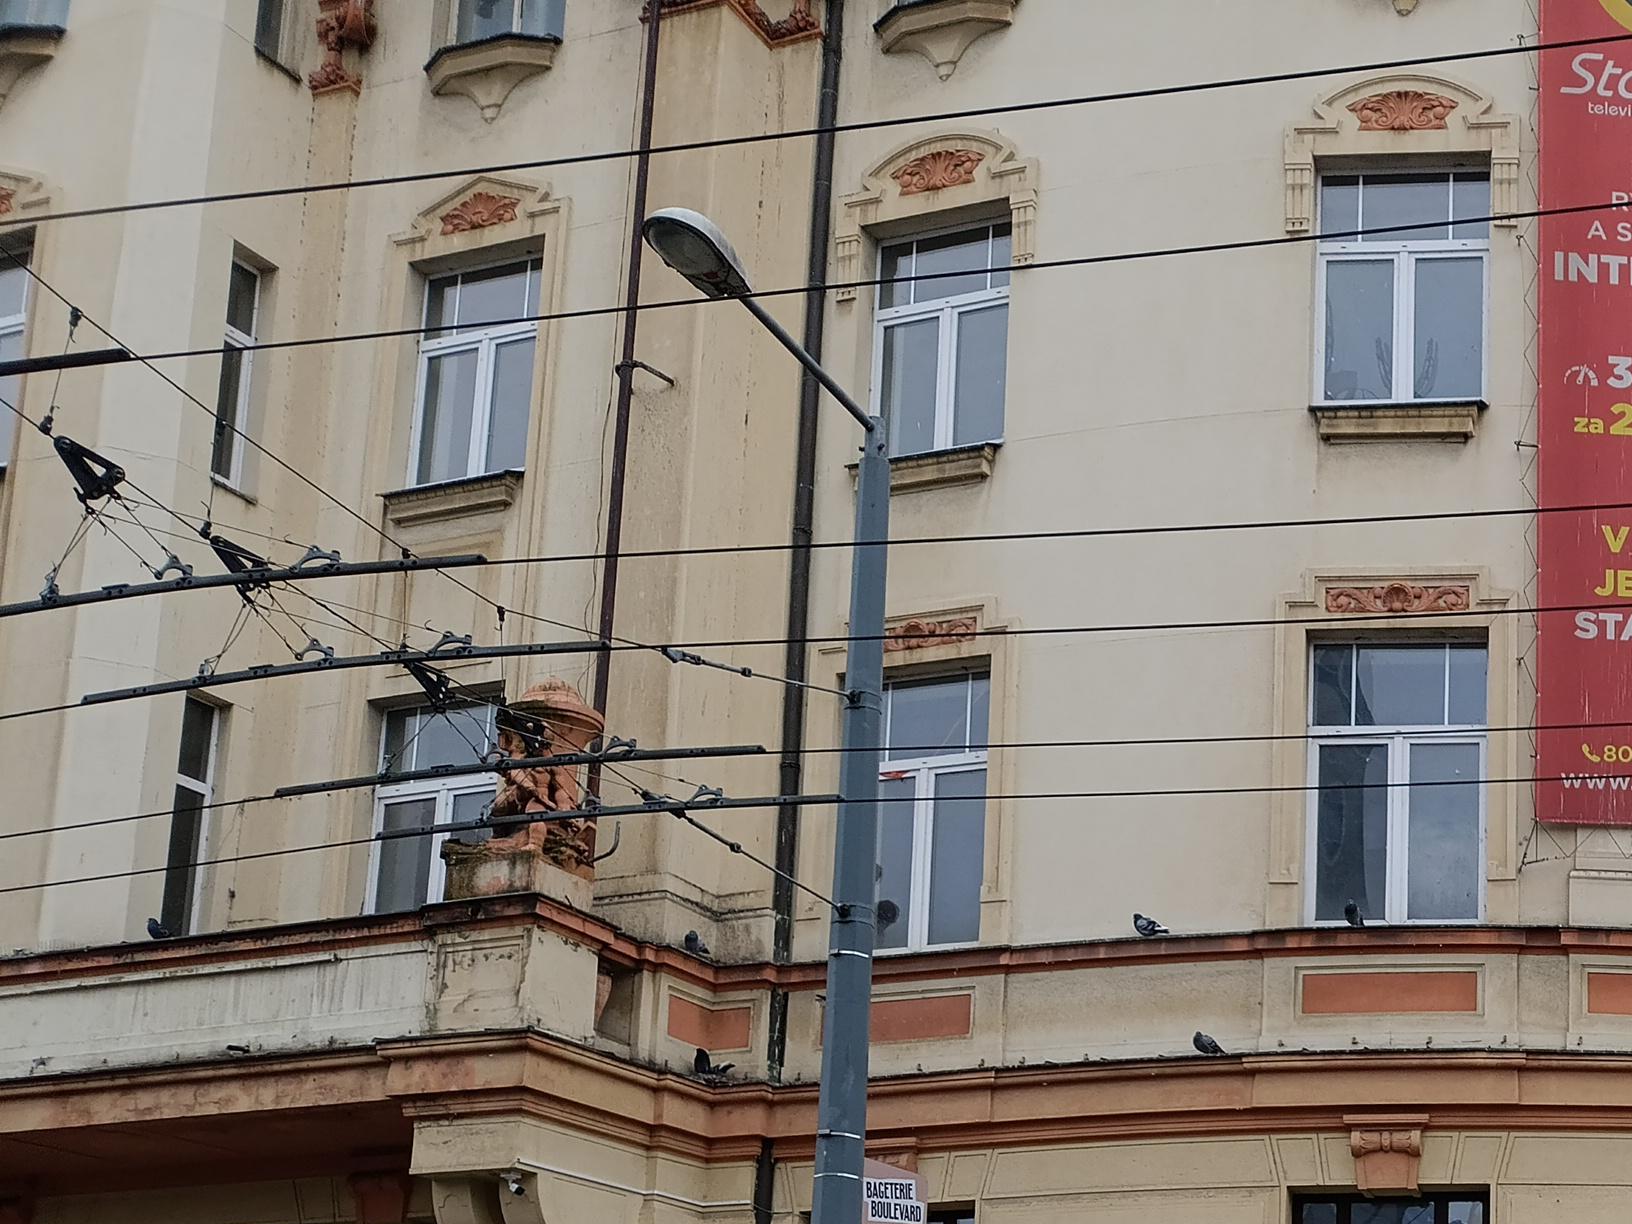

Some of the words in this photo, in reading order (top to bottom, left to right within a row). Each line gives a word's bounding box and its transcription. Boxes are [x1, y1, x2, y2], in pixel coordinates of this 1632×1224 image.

[1586, 219, 1607, 241] A
[1573, 416, 1604, 435] za
[1601, 524, 1631, 554] V
[866, 1181, 913, 1200] BAGETERIE
[871, 1201, 921, 1223] BOULEVARD
